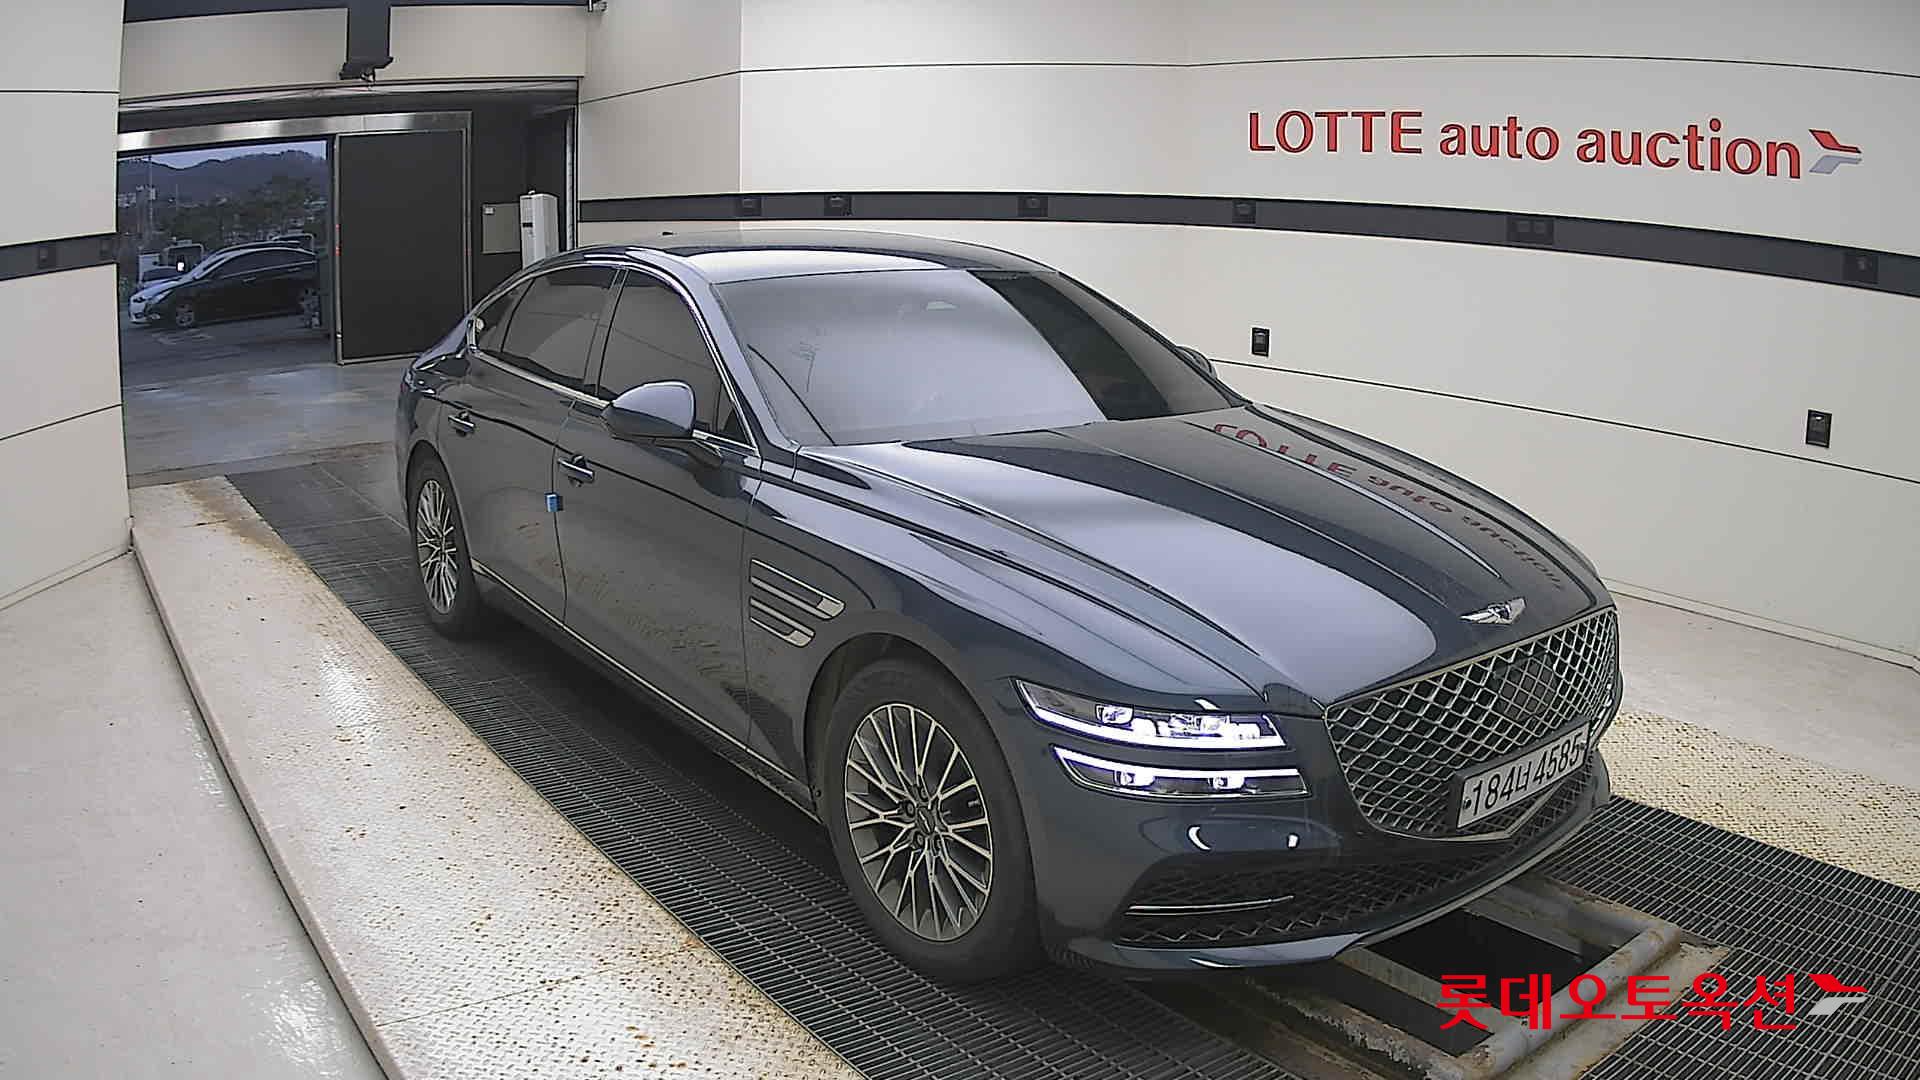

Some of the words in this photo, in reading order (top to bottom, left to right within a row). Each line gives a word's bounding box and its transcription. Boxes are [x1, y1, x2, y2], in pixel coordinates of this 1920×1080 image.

[1249, 111, 1420, 154] LOTTE
[1439, 116, 1560, 160] auto
[1576, 119, 1801, 179] auction
[1473, 761, 1533, 816] 184너
[1533, 733, 1584, 785] 4585
